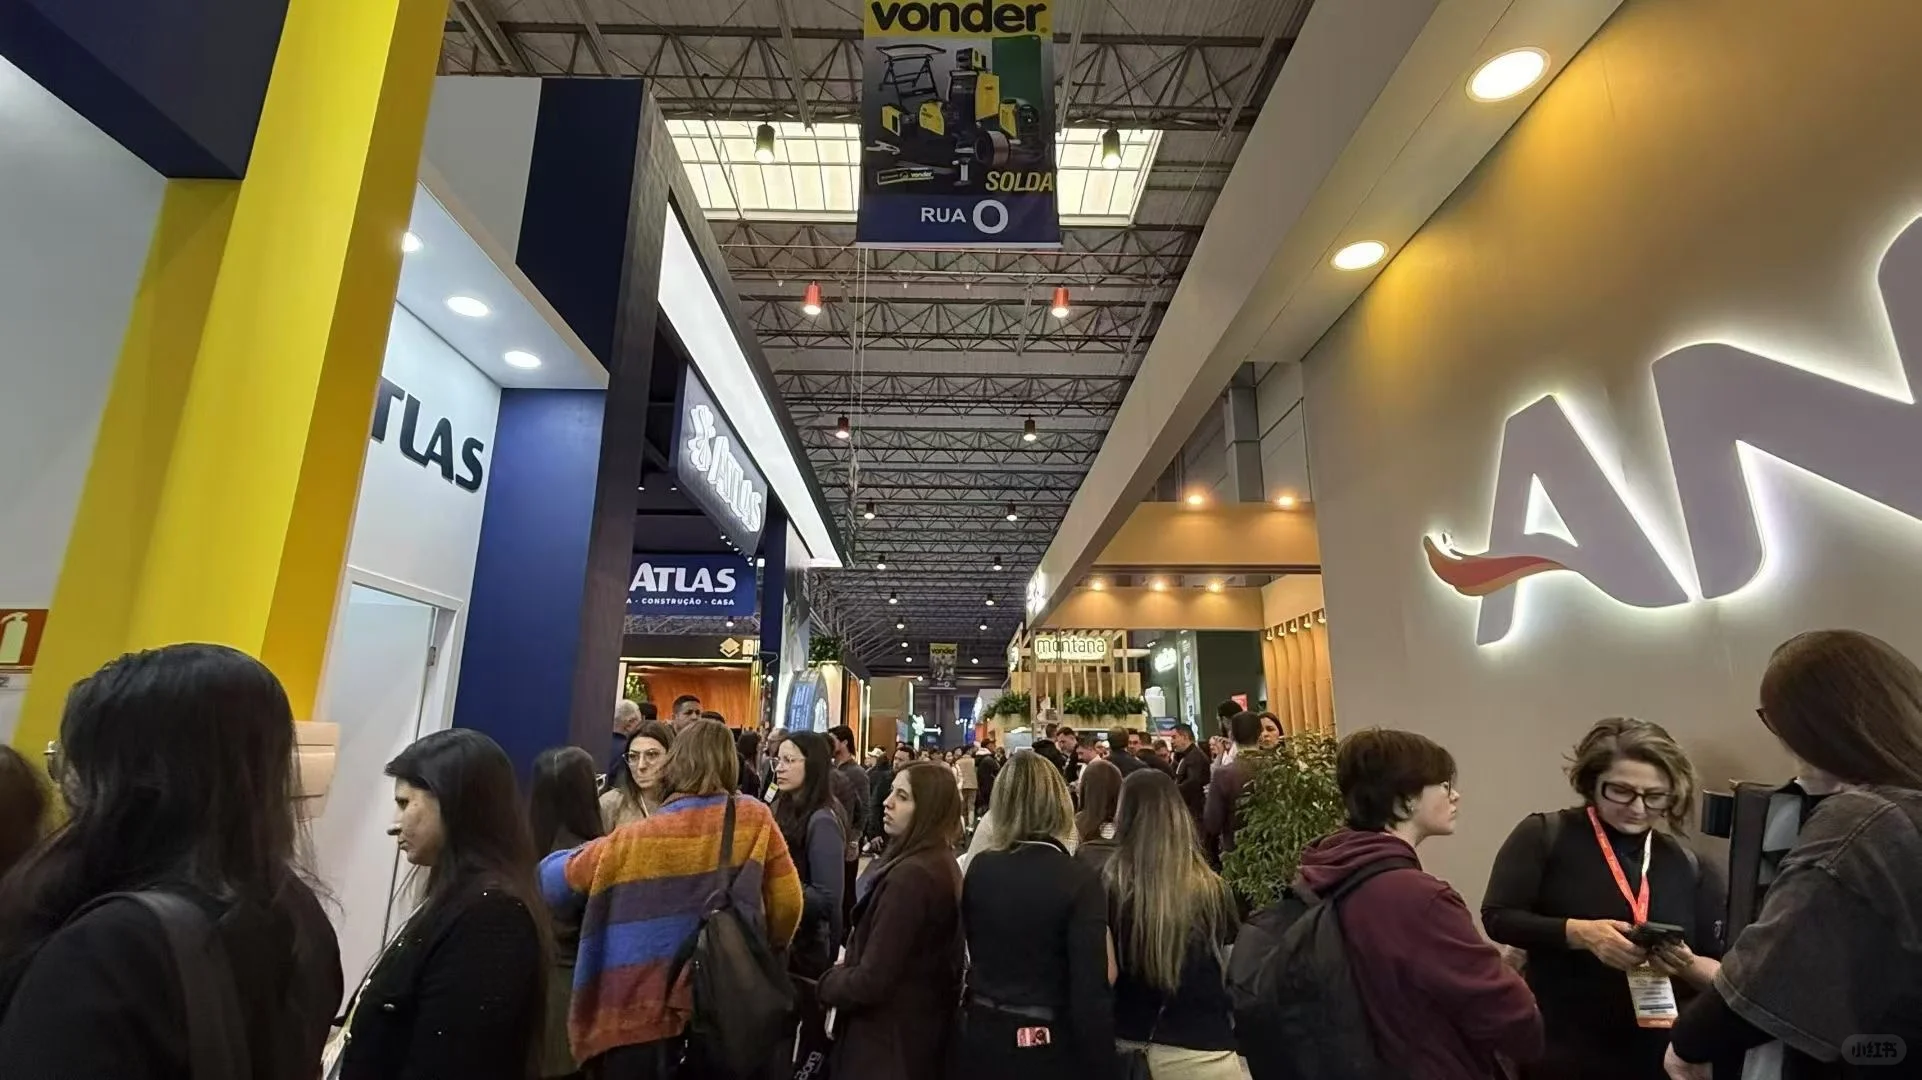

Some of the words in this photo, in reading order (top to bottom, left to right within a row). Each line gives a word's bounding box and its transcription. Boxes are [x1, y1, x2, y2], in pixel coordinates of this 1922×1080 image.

[871, 0, 1047, 33] vonder
[985, 171, 1053, 192] SOLDA
[920, 207, 966, 223] RUA
[973, 199, 1009, 234] O
[707, 435, 761, 533] ATLAS
[629, 562, 736, 593] ATLAS
[641, 597, 702, 606] CONSTRUÇÃO
[1037, 638, 1105, 653] montana
